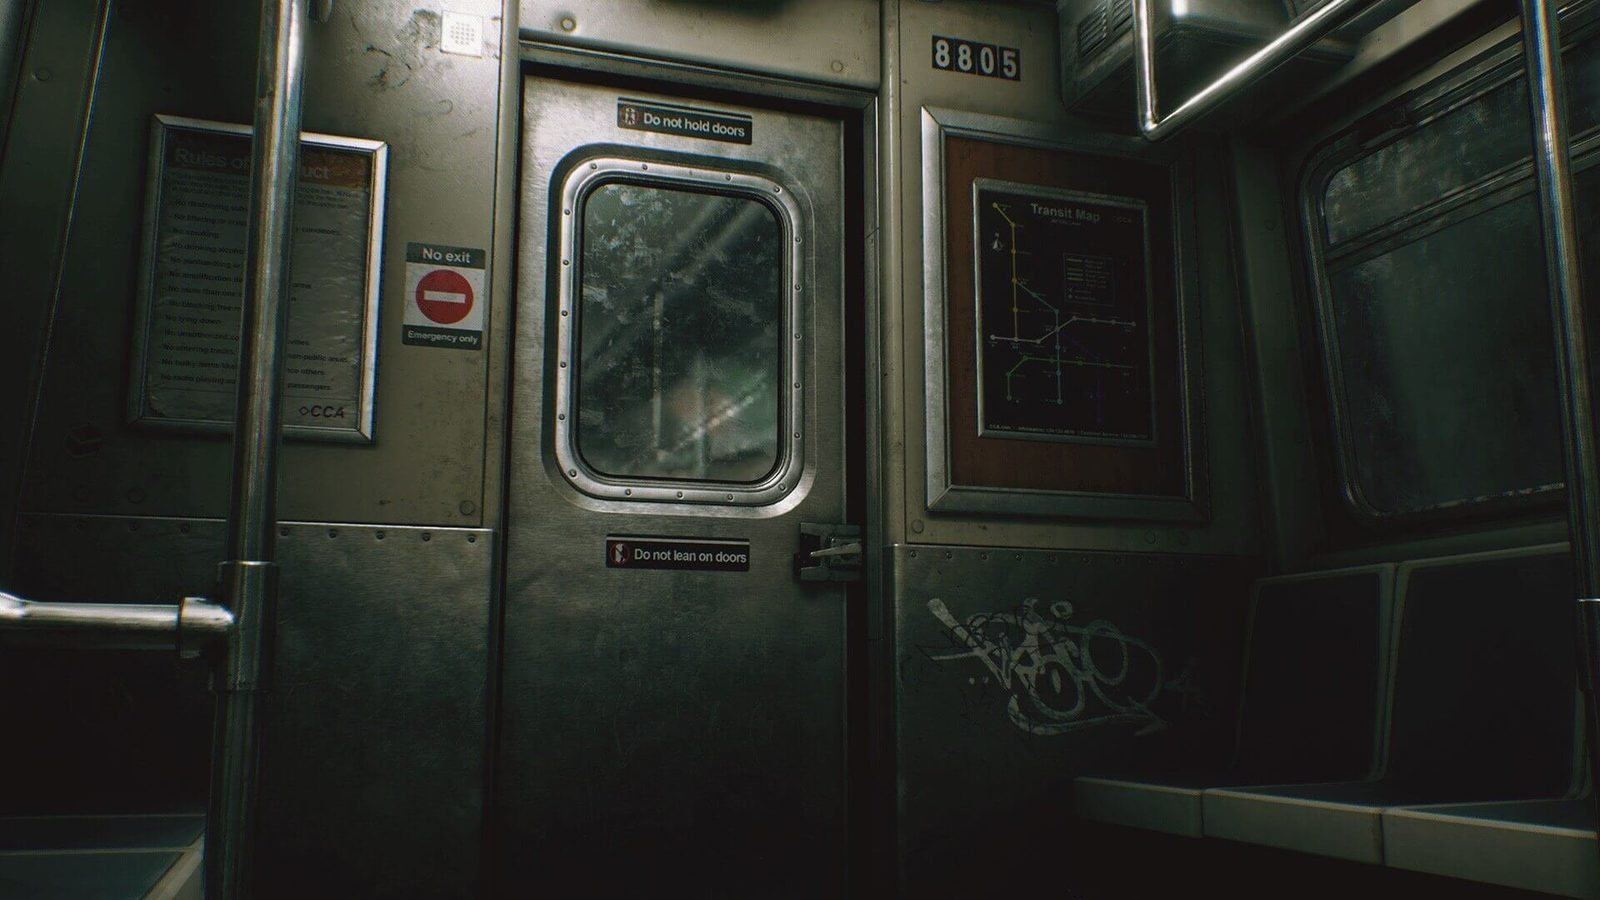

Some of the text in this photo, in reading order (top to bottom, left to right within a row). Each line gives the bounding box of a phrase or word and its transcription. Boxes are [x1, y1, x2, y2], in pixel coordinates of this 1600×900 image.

[935, 39, 1017, 78] 8805
[643, 112, 745, 137] Do not hold doors
[175, 147, 226, 168] Rules
[1030, 203, 1073, 219] Transit
[1075, 209, 1100, 223] Map
[422, 248, 470, 263] No exit
[408, 330, 478, 345] Emergency only
[311, 405, 344, 419] CCA
[634, 548, 747, 563] Do not lean on doors
